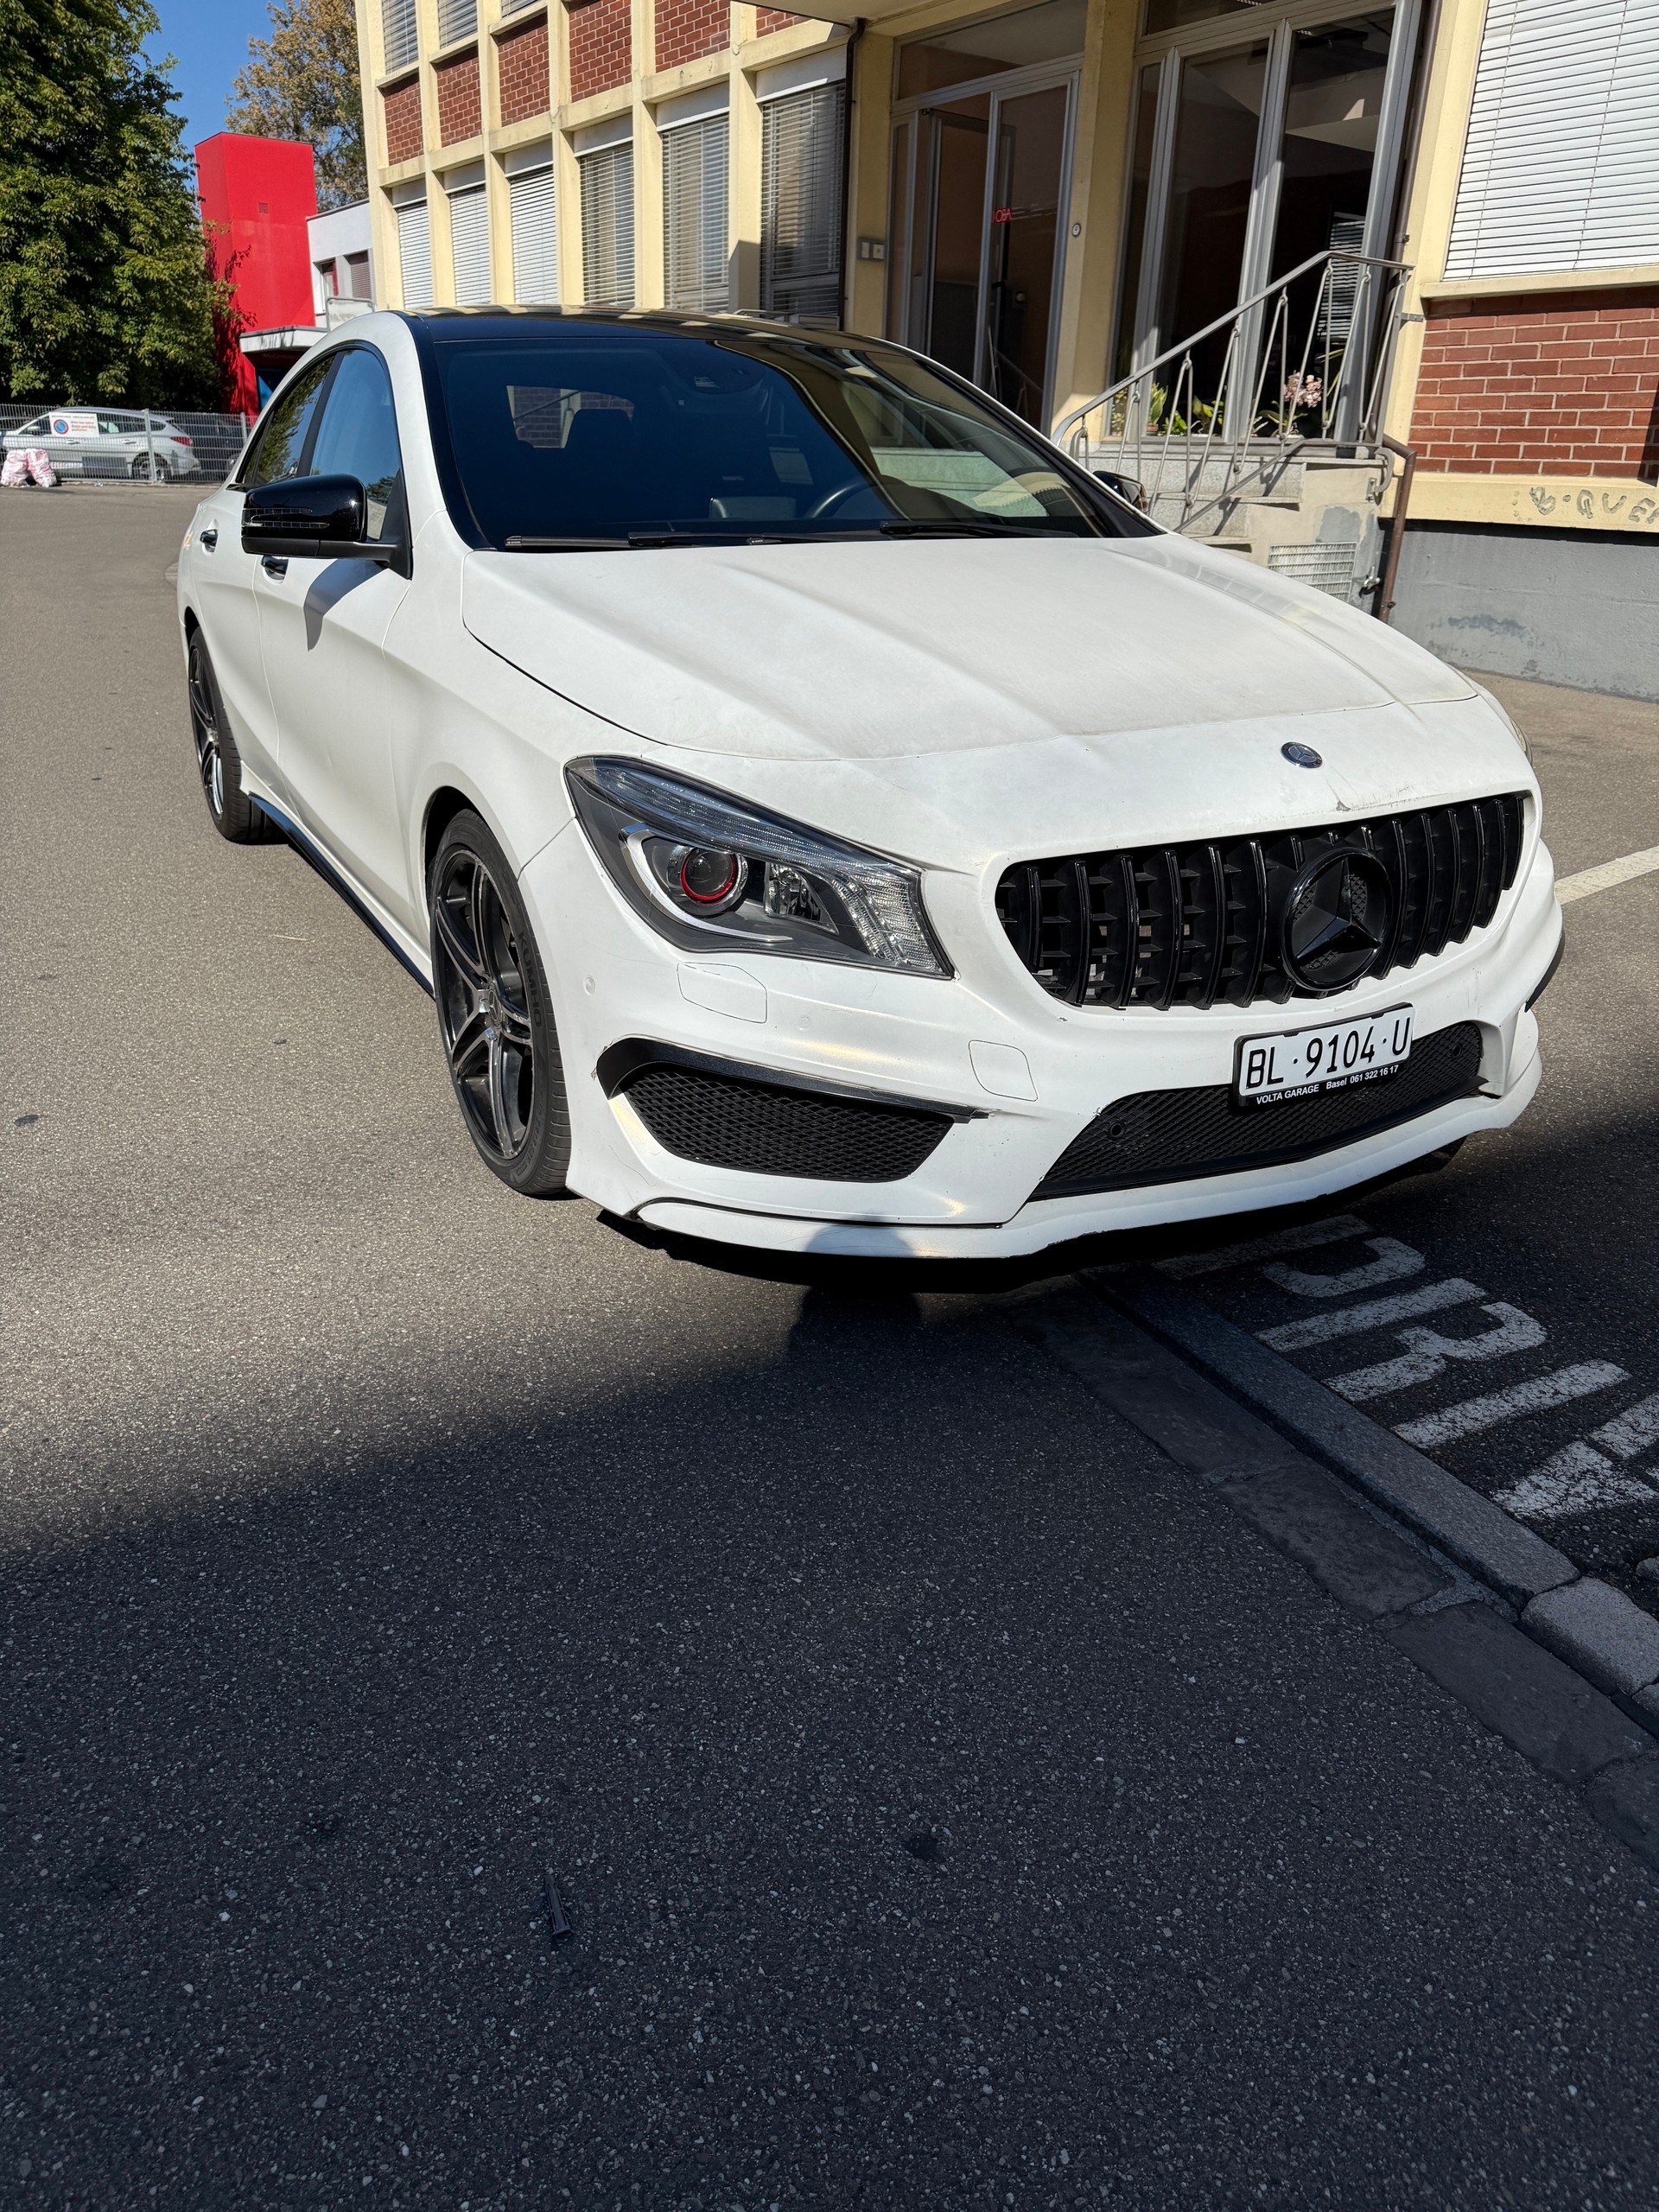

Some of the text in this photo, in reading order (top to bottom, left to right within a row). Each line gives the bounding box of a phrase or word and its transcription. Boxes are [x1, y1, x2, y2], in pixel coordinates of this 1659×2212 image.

[518, 931, 542, 1027] KUMHO
[1256, 1065, 1399, 1105] VOLTA GARAGE Basel 061 322 16 17
